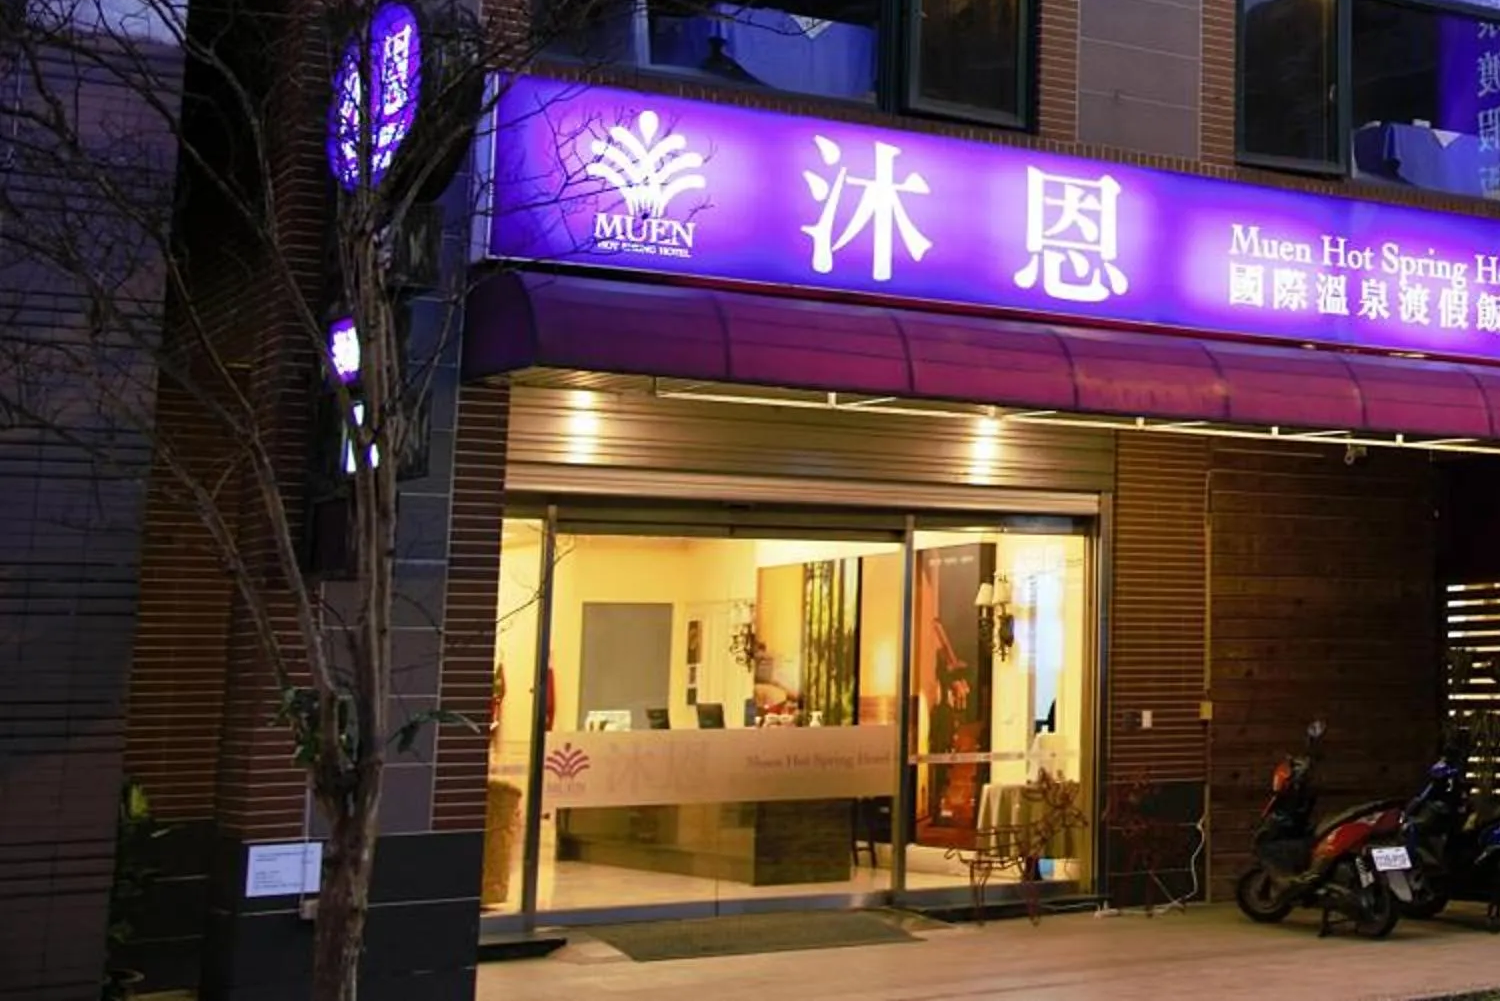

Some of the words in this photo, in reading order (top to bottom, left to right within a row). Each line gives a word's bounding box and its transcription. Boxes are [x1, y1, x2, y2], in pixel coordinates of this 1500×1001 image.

[594, 212, 696, 248] MUEN
[801, 134, 1130, 303] 沐恩
[1229, 224, 1311, 263] Muen
[1321, 235, 1374, 271] Hot
[1381, 242, 1468, 288] Spring
